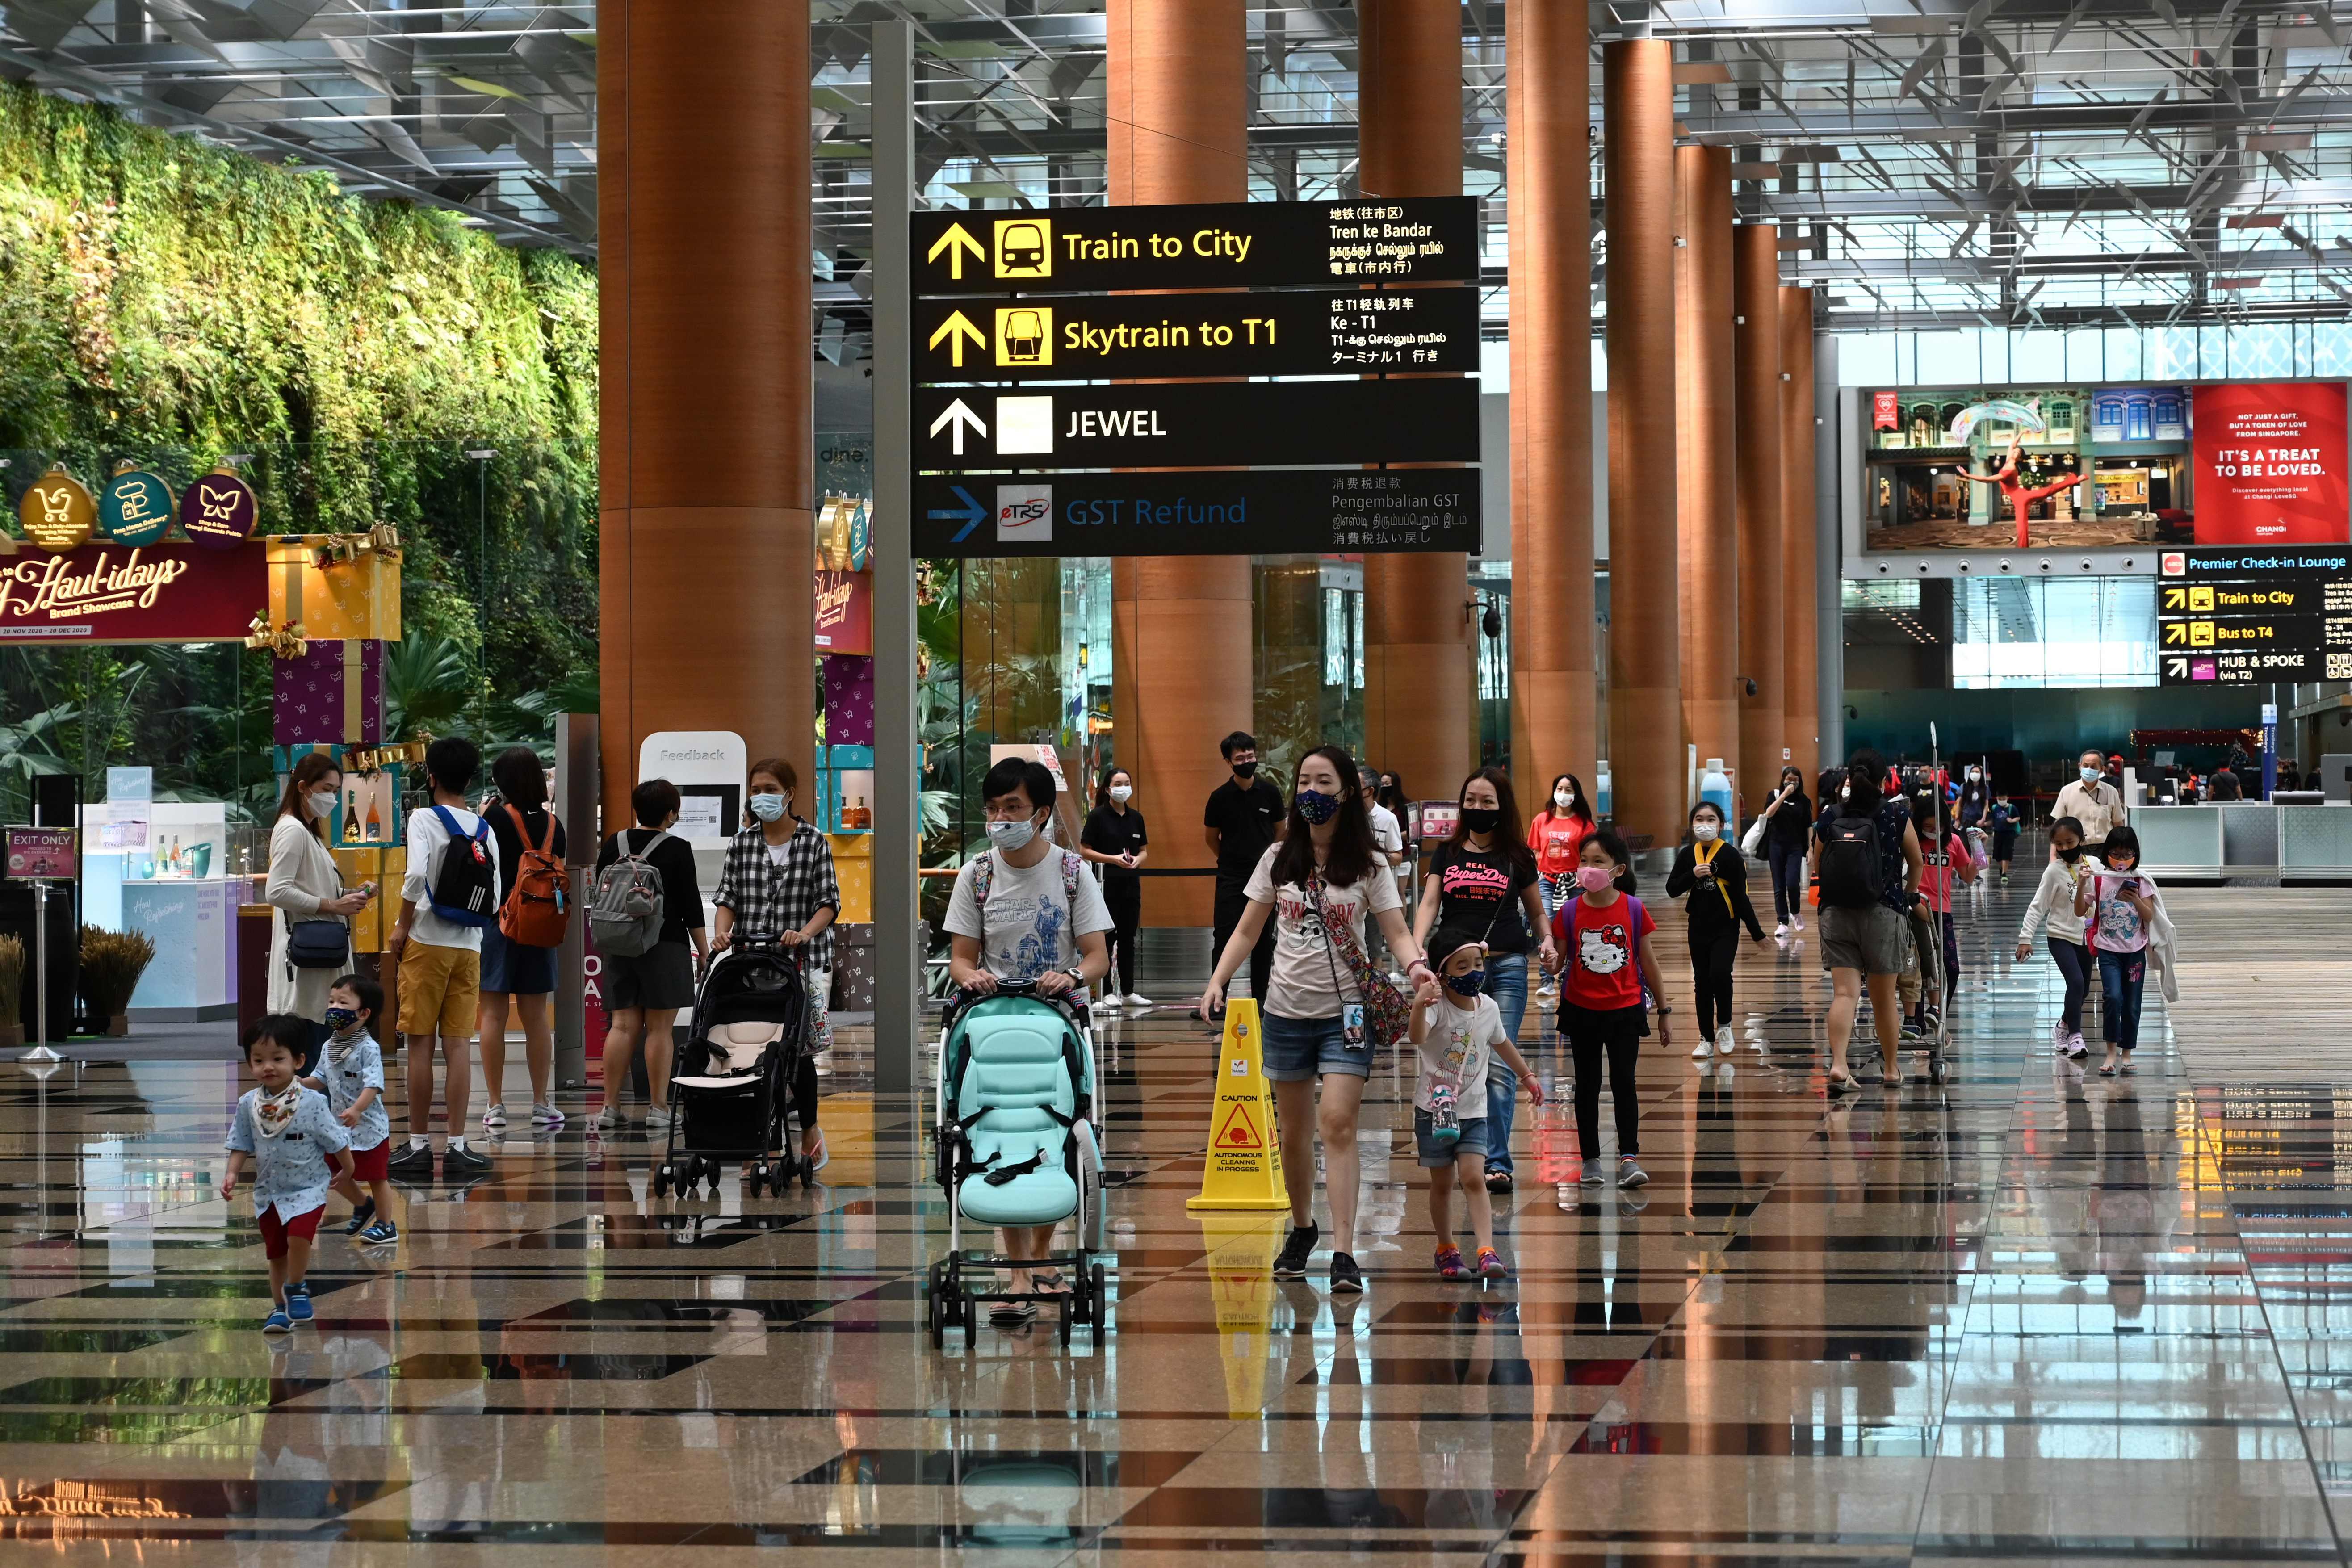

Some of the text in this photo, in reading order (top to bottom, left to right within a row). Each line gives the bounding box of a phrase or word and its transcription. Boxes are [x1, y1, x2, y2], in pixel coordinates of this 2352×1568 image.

[1329, 222, 1432, 239] Tren ke Bandar
[1063, 229, 1252, 263] Train to City
[1331, 316, 1347, 330] Ke
[1361, 315, 1375, 329] T1
[1065, 319, 1275, 355] Skytrain to T1
[1413, 349, 1438, 363] 行き
[1066, 410, 1167, 437] JEWEL
[820, 447, 869, 463] dine.
[2219, 448, 2321, 462] IT'S A TREAT
[2215, 463, 2326, 477] TO BE LOVED.
[1333, 477, 1401, 490] 消费税退款
[2260, 486, 2292, 495] everything
[1333, 494, 1460, 511] Pengembalian GST
[1067, 497, 1245, 524] GST Refund
[126, 522, 143, 531] Home
[185, 523, 203, 532] Changi
[203, 526, 226, 535] Rewards
[1333, 531, 1430, 545] 消費税払い戻し
[2189, 557, 2346, 570] Premier Check-in Lounge
[2217, 591, 2294, 605] Train to City
[50, 599, 135, 619] Brand Showcase
[2218, 627, 2273, 639] Bus to T4
[2219, 656, 2247, 668] HUB
[2251, 656, 2260, 667] &
[2263, 655, 2305, 667] SPOKE
[2220, 671, 2253, 681] (via T2)
[661, 749, 725, 761] Feedback
[14, 835, 71, 845] EXIT ONLY
[134, 897, 151, 914] How
[984, 898, 1036, 911] STAR
[986, 909, 1036, 922] WARS
